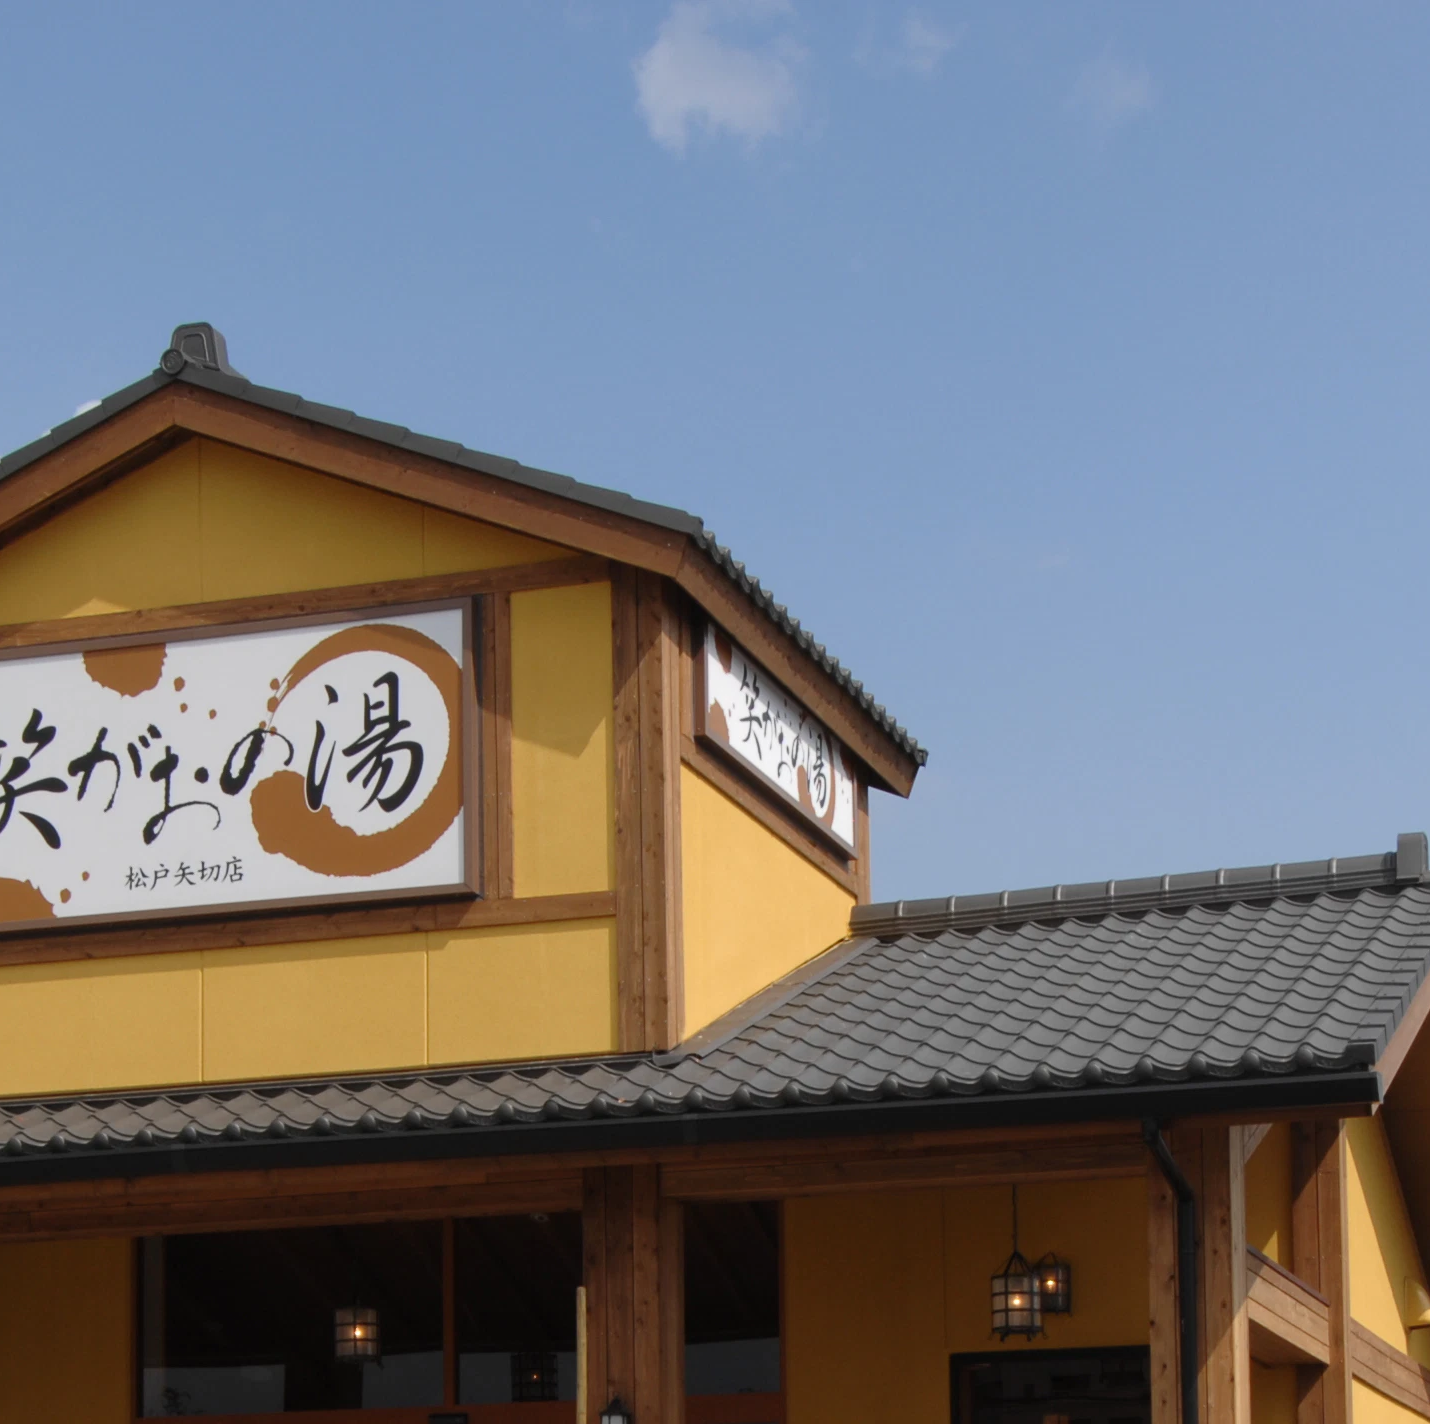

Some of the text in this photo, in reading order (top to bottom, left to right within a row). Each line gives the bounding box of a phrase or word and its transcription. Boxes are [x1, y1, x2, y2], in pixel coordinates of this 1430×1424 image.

[125, 856, 244, 891] 松戸矢切店
